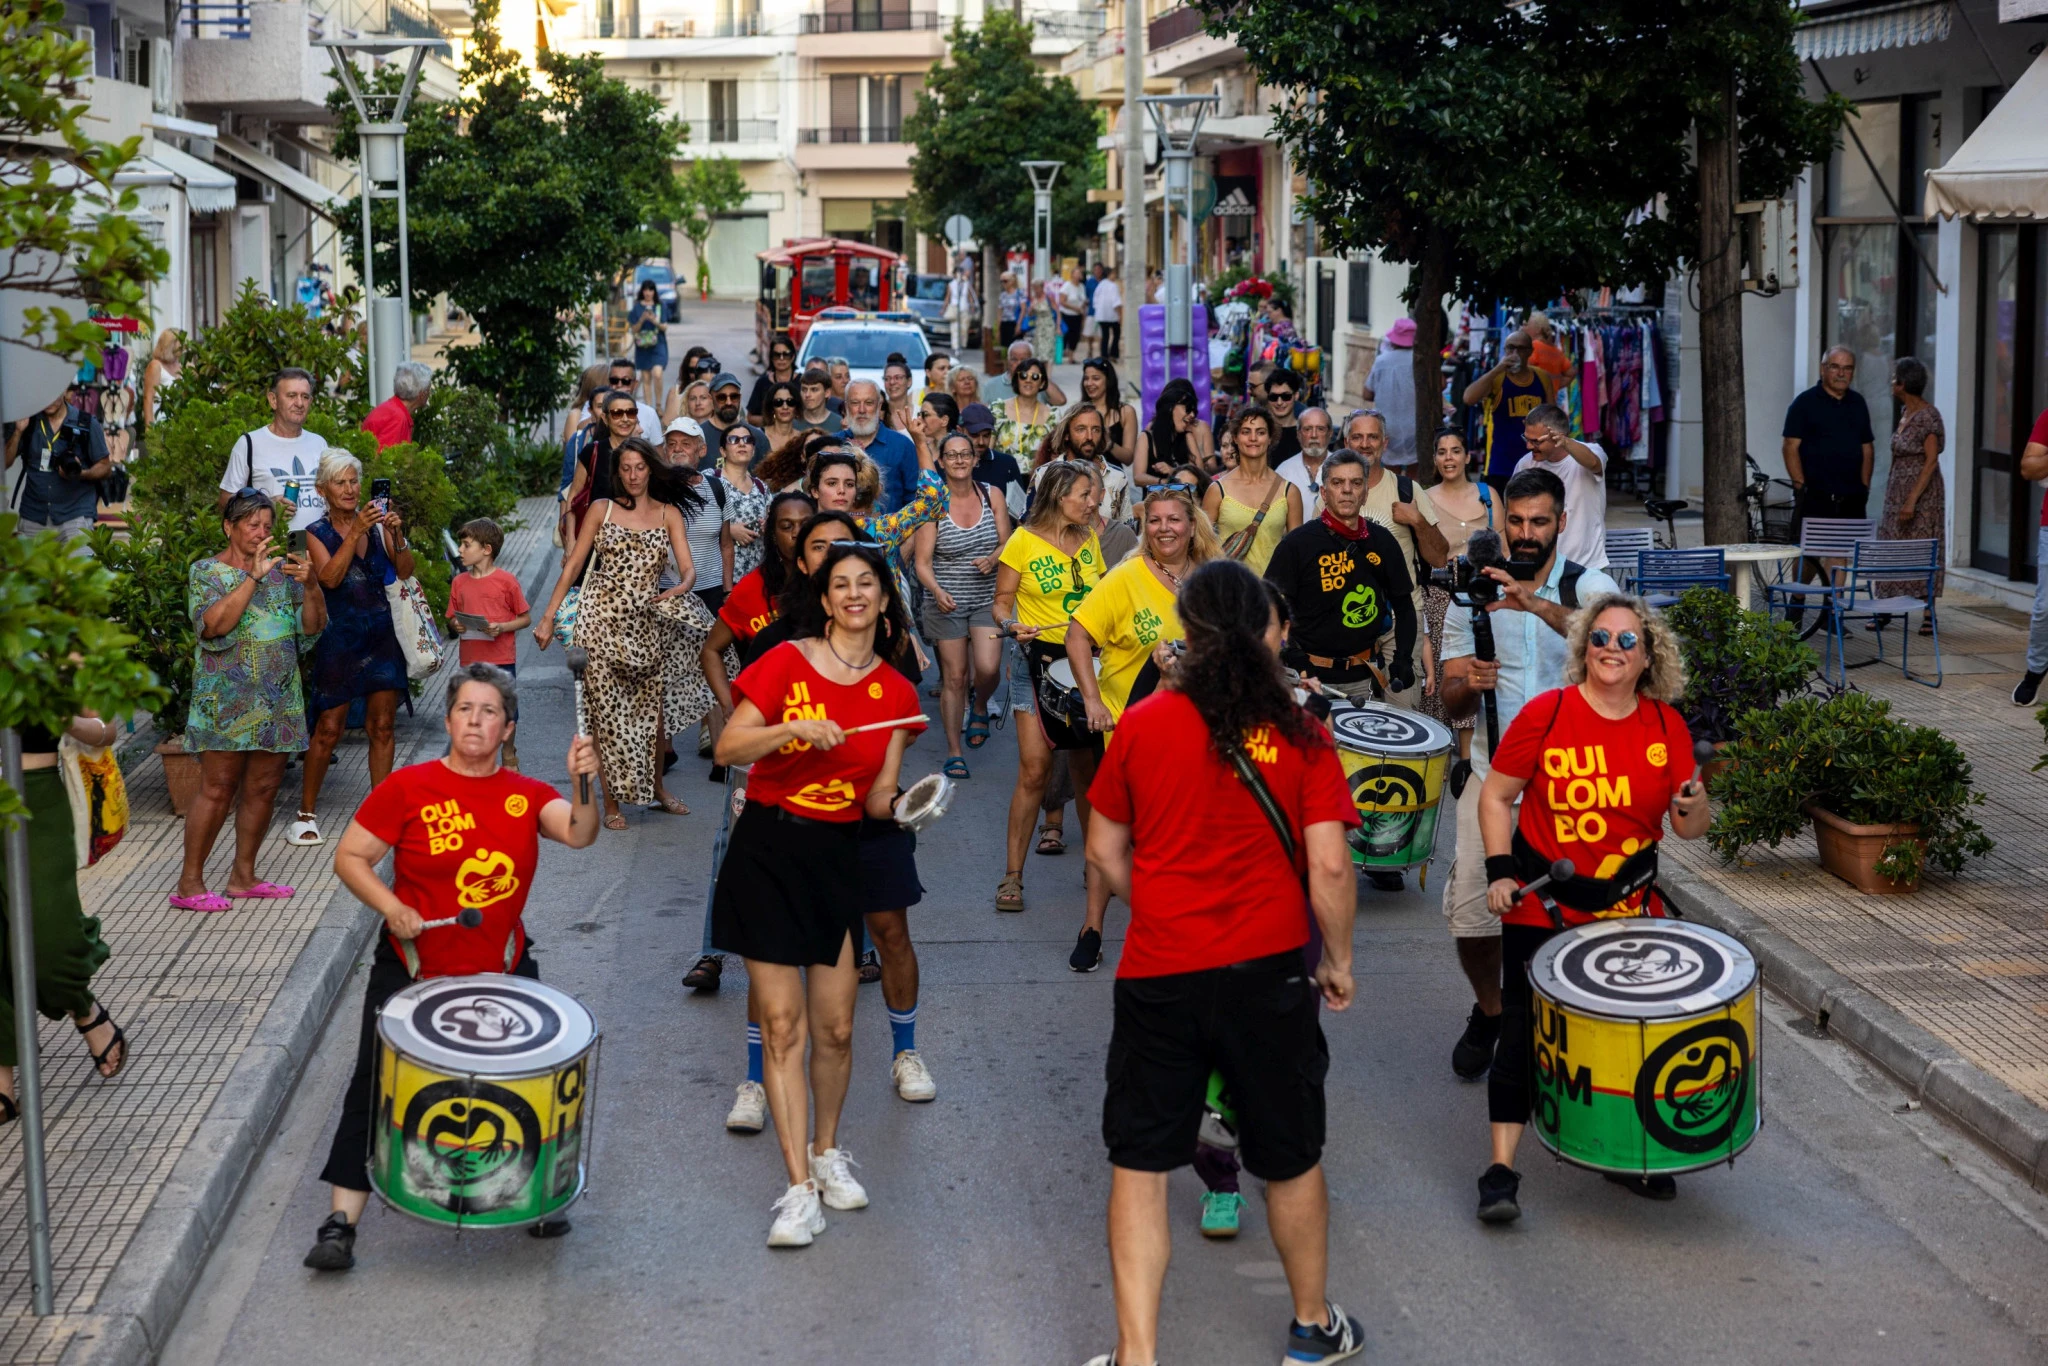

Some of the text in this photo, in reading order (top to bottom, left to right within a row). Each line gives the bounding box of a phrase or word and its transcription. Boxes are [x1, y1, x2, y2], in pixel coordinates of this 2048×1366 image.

[1213, 205, 1256, 216] adidas
[297, 494, 324, 508] idas
[1029, 555, 1055, 572] QUI
[1318, 551, 1347, 567] QUI
[1320, 559, 1355, 578] LOM
[1034, 563, 1066, 582] LOM
[1040, 578, 1062, 594] BO
[1321, 576, 1346, 592] BO
[1133, 608, 1152, 625] QUI
[1134, 615, 1162, 636] LOM
[1139, 630, 1158, 646] BO
[784, 681, 811, 706] UI
[782, 703, 827, 723] OM
[1242, 728, 1269, 745] UI
[1244, 743, 1278, 764] OM
[1544, 745, 1608, 779] QUI
[1548, 775, 1632, 811] LOM
[420, 799, 460, 823] QUI
[426, 813, 476, 839] LOM
[1554, 811, 1607, 843] BO
[429, 833, 463, 856] BO
[1536, 1042, 1592, 1107] OM
